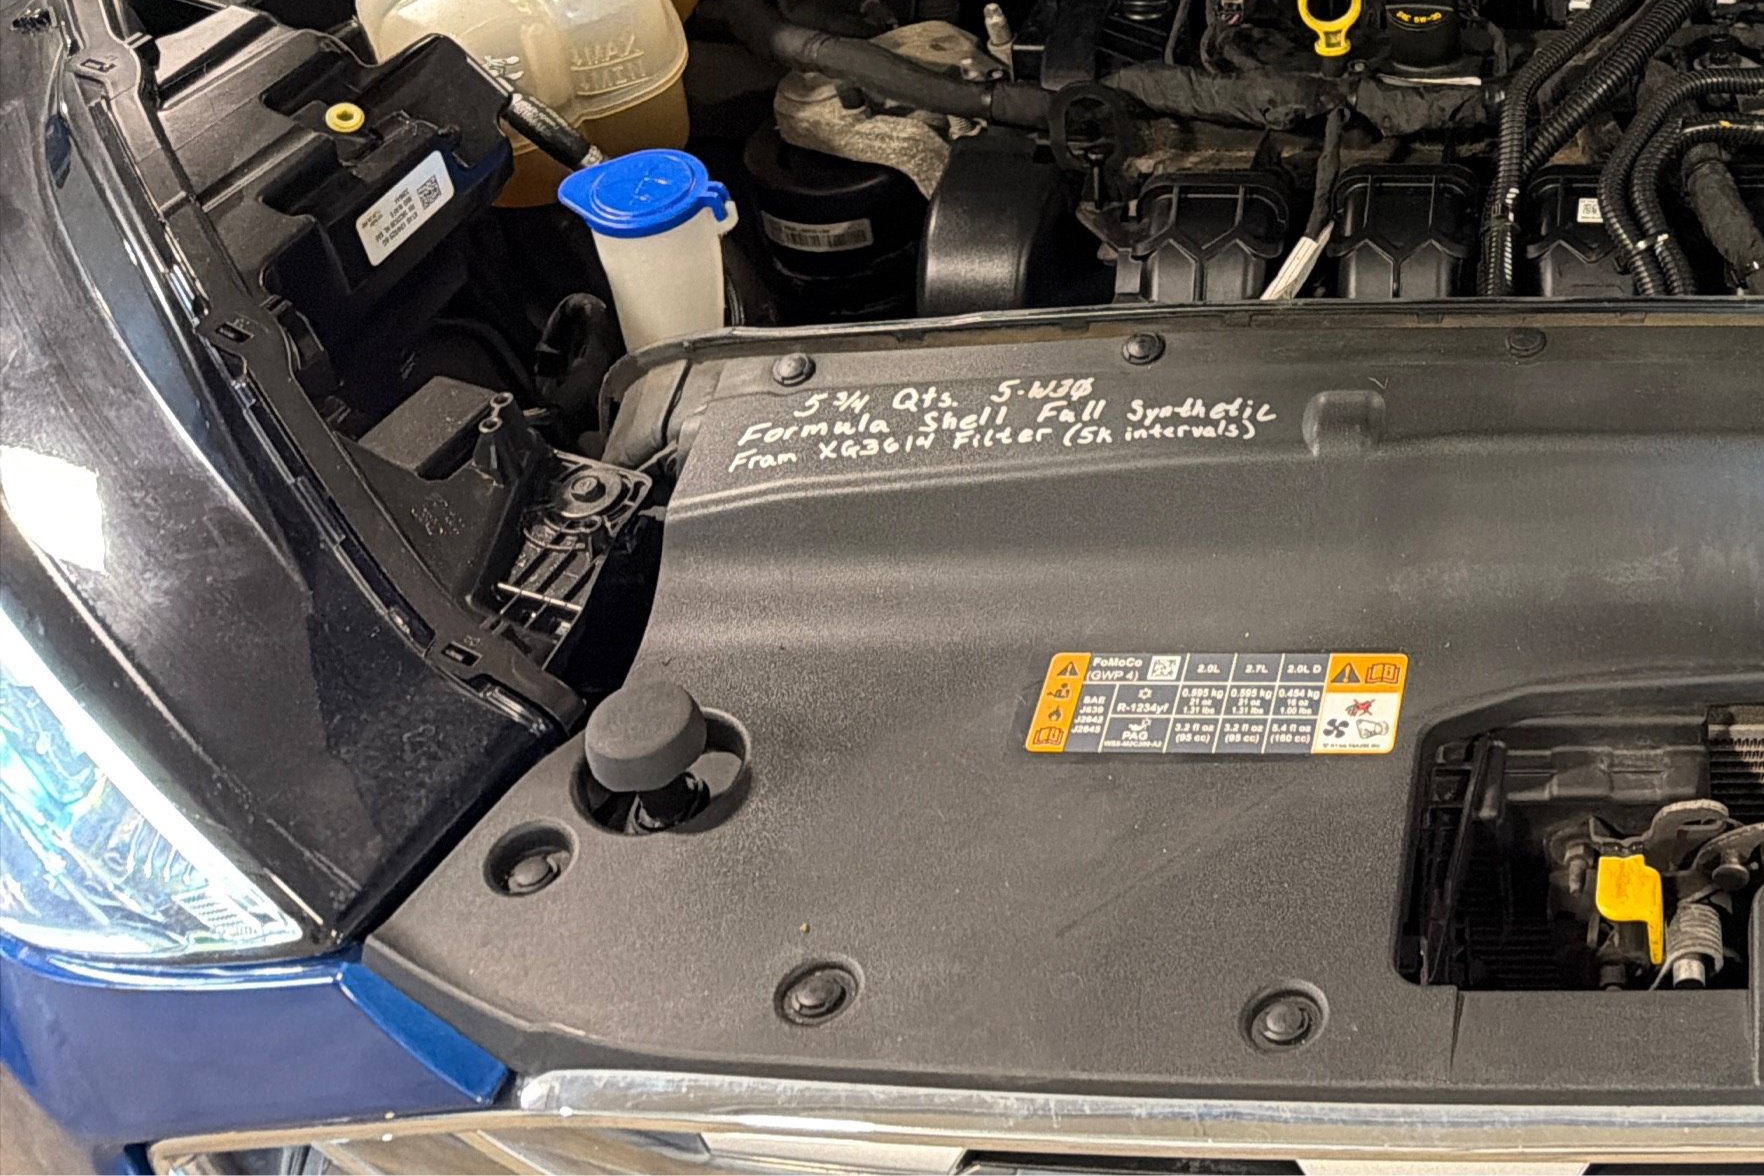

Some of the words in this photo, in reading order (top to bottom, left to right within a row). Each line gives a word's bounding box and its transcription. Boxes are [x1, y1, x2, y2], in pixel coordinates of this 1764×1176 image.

[793, 391, 829, 417] 5
[892, 386, 959, 412] Qts.
[737, 412, 891, 446] Formula
[918, 406, 1008, 432] Shell
[1126, 397, 1277, 426] Synthetic
[728, 448, 797, 473] Fram
[953, 427, 1052, 450] Filter
[1124, 419, 1256, 442] intervals)
[1092, 657, 1143, 668] FoMoCo
[1196, 663, 1221, 674] 2.0L
[1244, 663, 1269, 674] 2.7L
[1286, 663, 1311, 674] 2.0L
[1312, 664, 1322, 674] D
[1086, 670, 1125, 682] (GWP
[1125, 670, 1140, 682] 4)
[1210, 688, 1224, 700] kg
[1258, 688, 1273, 700] kg
[1307, 689, 1321, 701] kg
[1116, 702, 1170, 714] R-1234yf
[1223, 723, 1240, 732] 3.2
[1121, 730, 1149, 741] PAG
